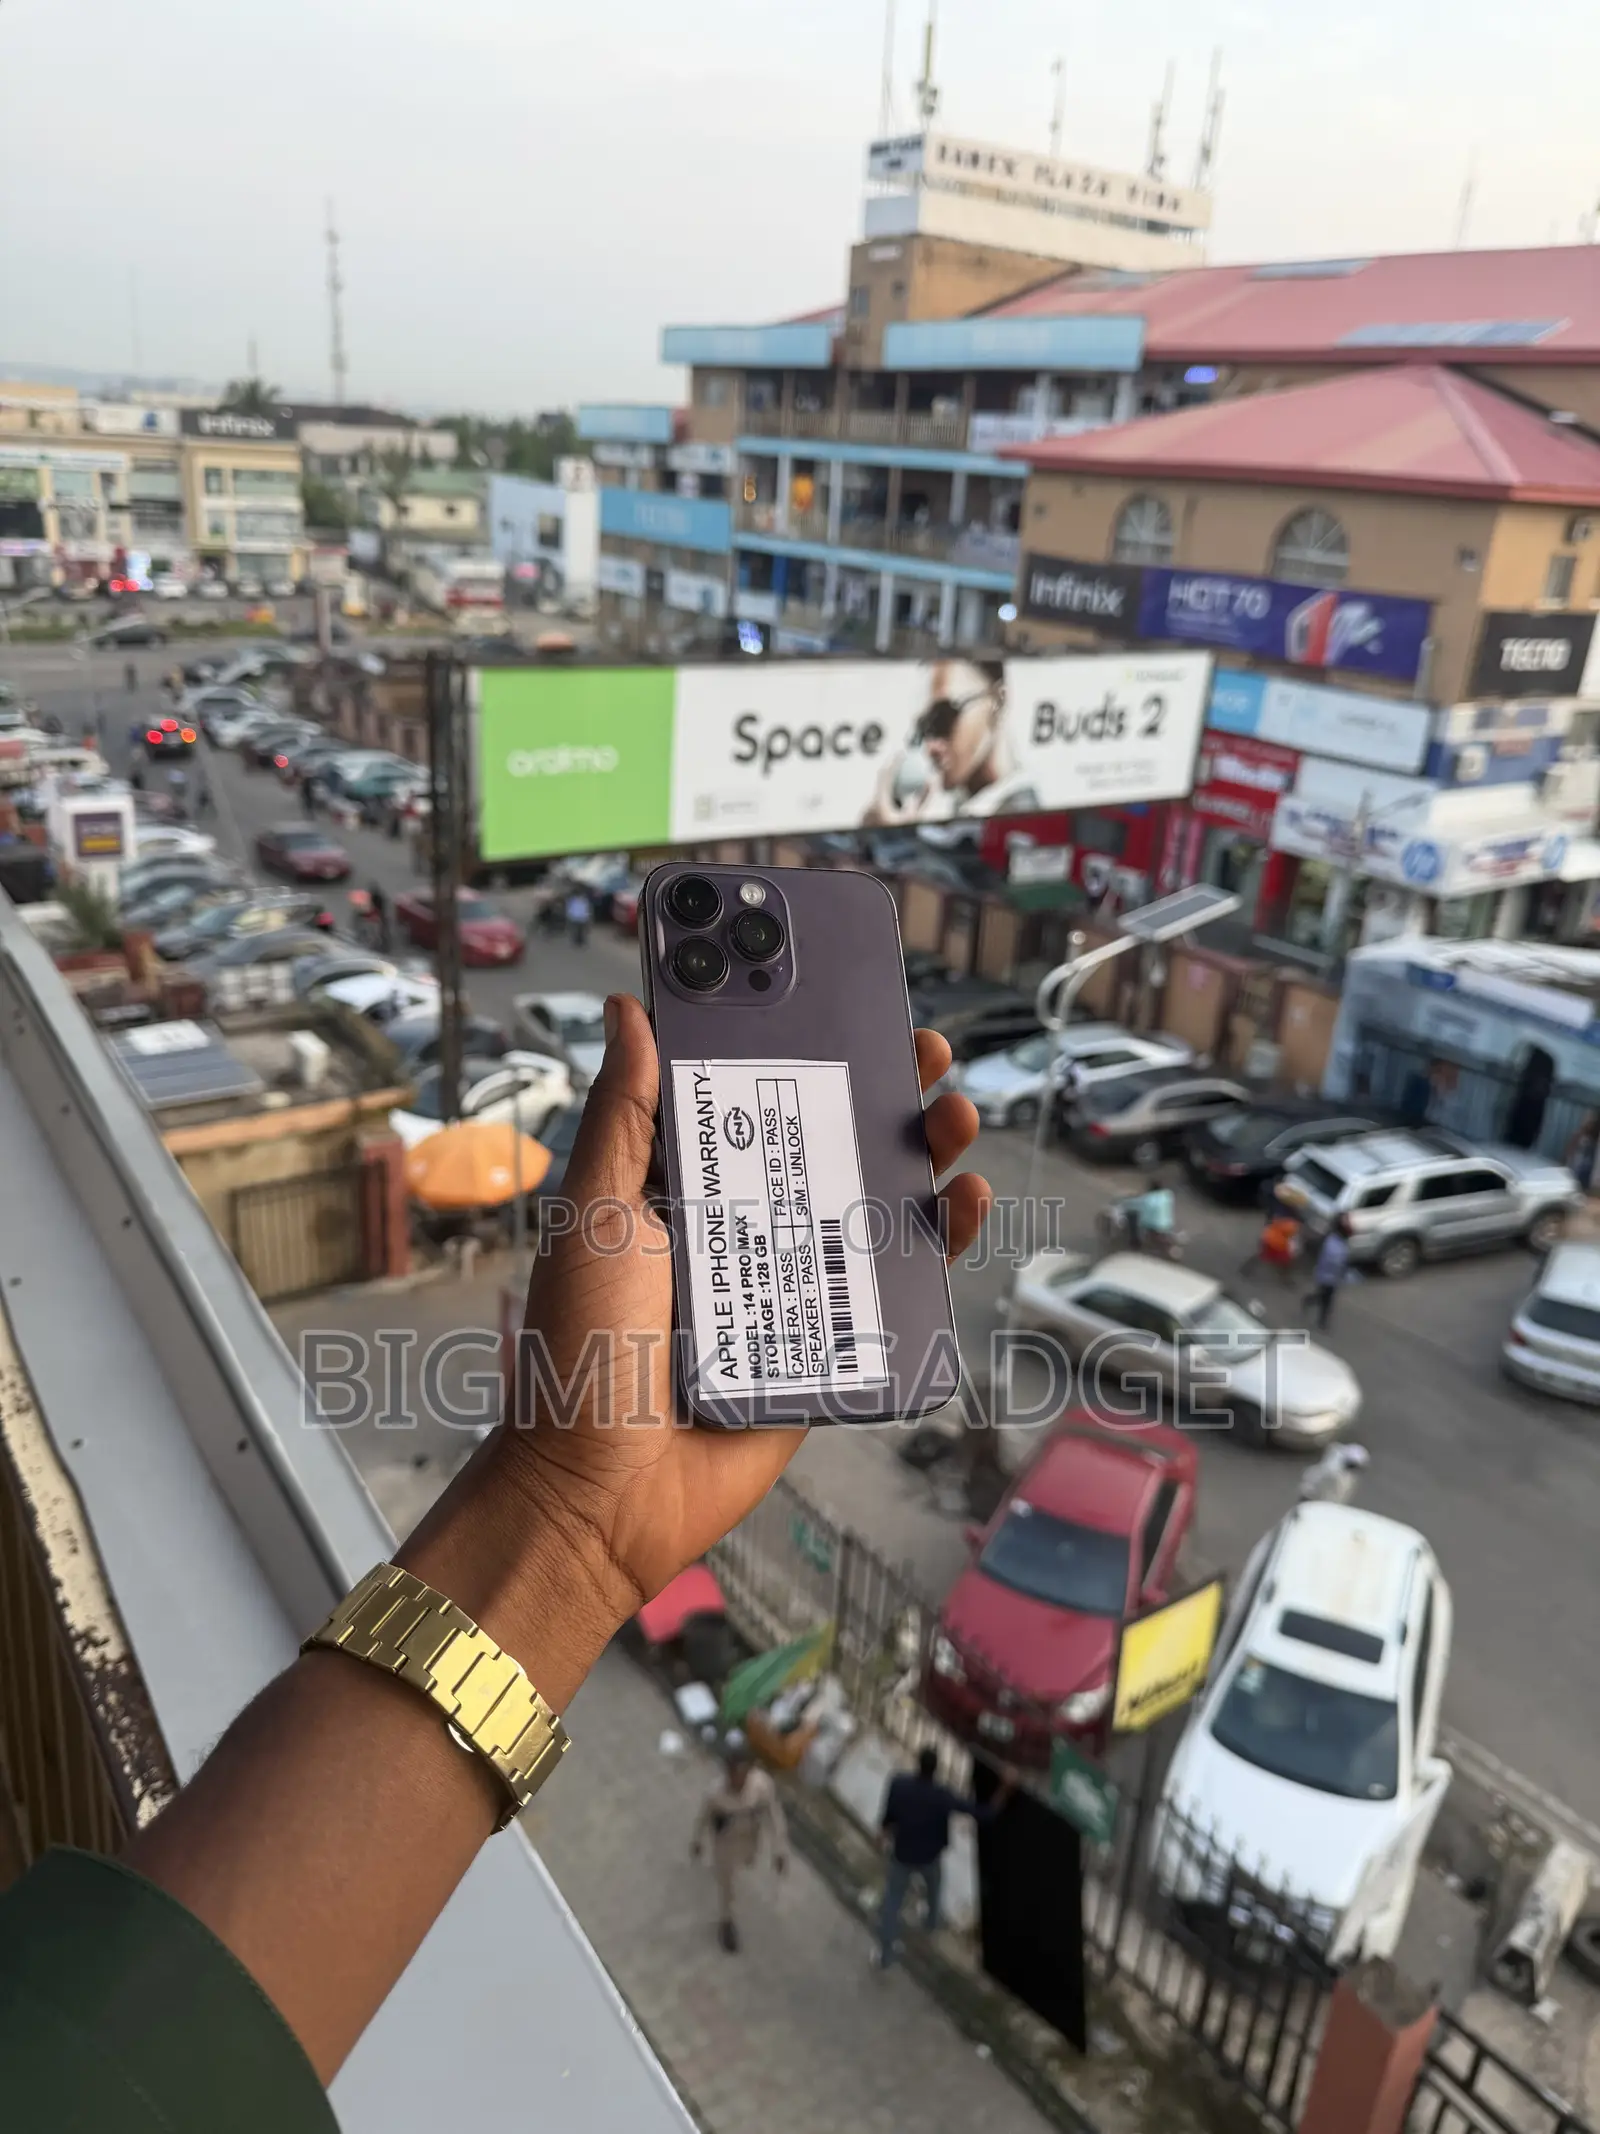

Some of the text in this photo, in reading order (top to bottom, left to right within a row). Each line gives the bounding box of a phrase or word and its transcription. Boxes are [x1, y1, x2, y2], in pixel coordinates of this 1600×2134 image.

[1029, 570, 1126, 618] Infinix
[1500, 637, 1572, 672] TECNO
[1032, 692, 1126, 745] Buds
[1138, 690, 1167, 739] 2
[506, 744, 619, 778] oraimo
[732, 712, 884, 778] Space
[764, 1107, 779, 1146] PASS
[786, 1115, 803, 1177] UNLOCK
[769, 1157, 781, 1174] ID
[771, 1177, 787, 1216] FACE
[793, 1189, 808, 1216] SIM
[693, 1072, 739, 1379] APPLE IPHONE WARRANTY
[735, 1215, 748, 1250] MAX
[754, 1234, 767, 1260] GB
[799, 1244, 815, 1284] PASS
[739, 1254, 753, 1289] PRO
[780, 1252, 795, 1293] PASS
[746, 1321, 762, 1379] MODEL
[760, 1298, 779, 1379] STORAGE
[786, 1304, 804, 1375] CAMERA
[804, 1297, 825, 1374] SPEAKER
